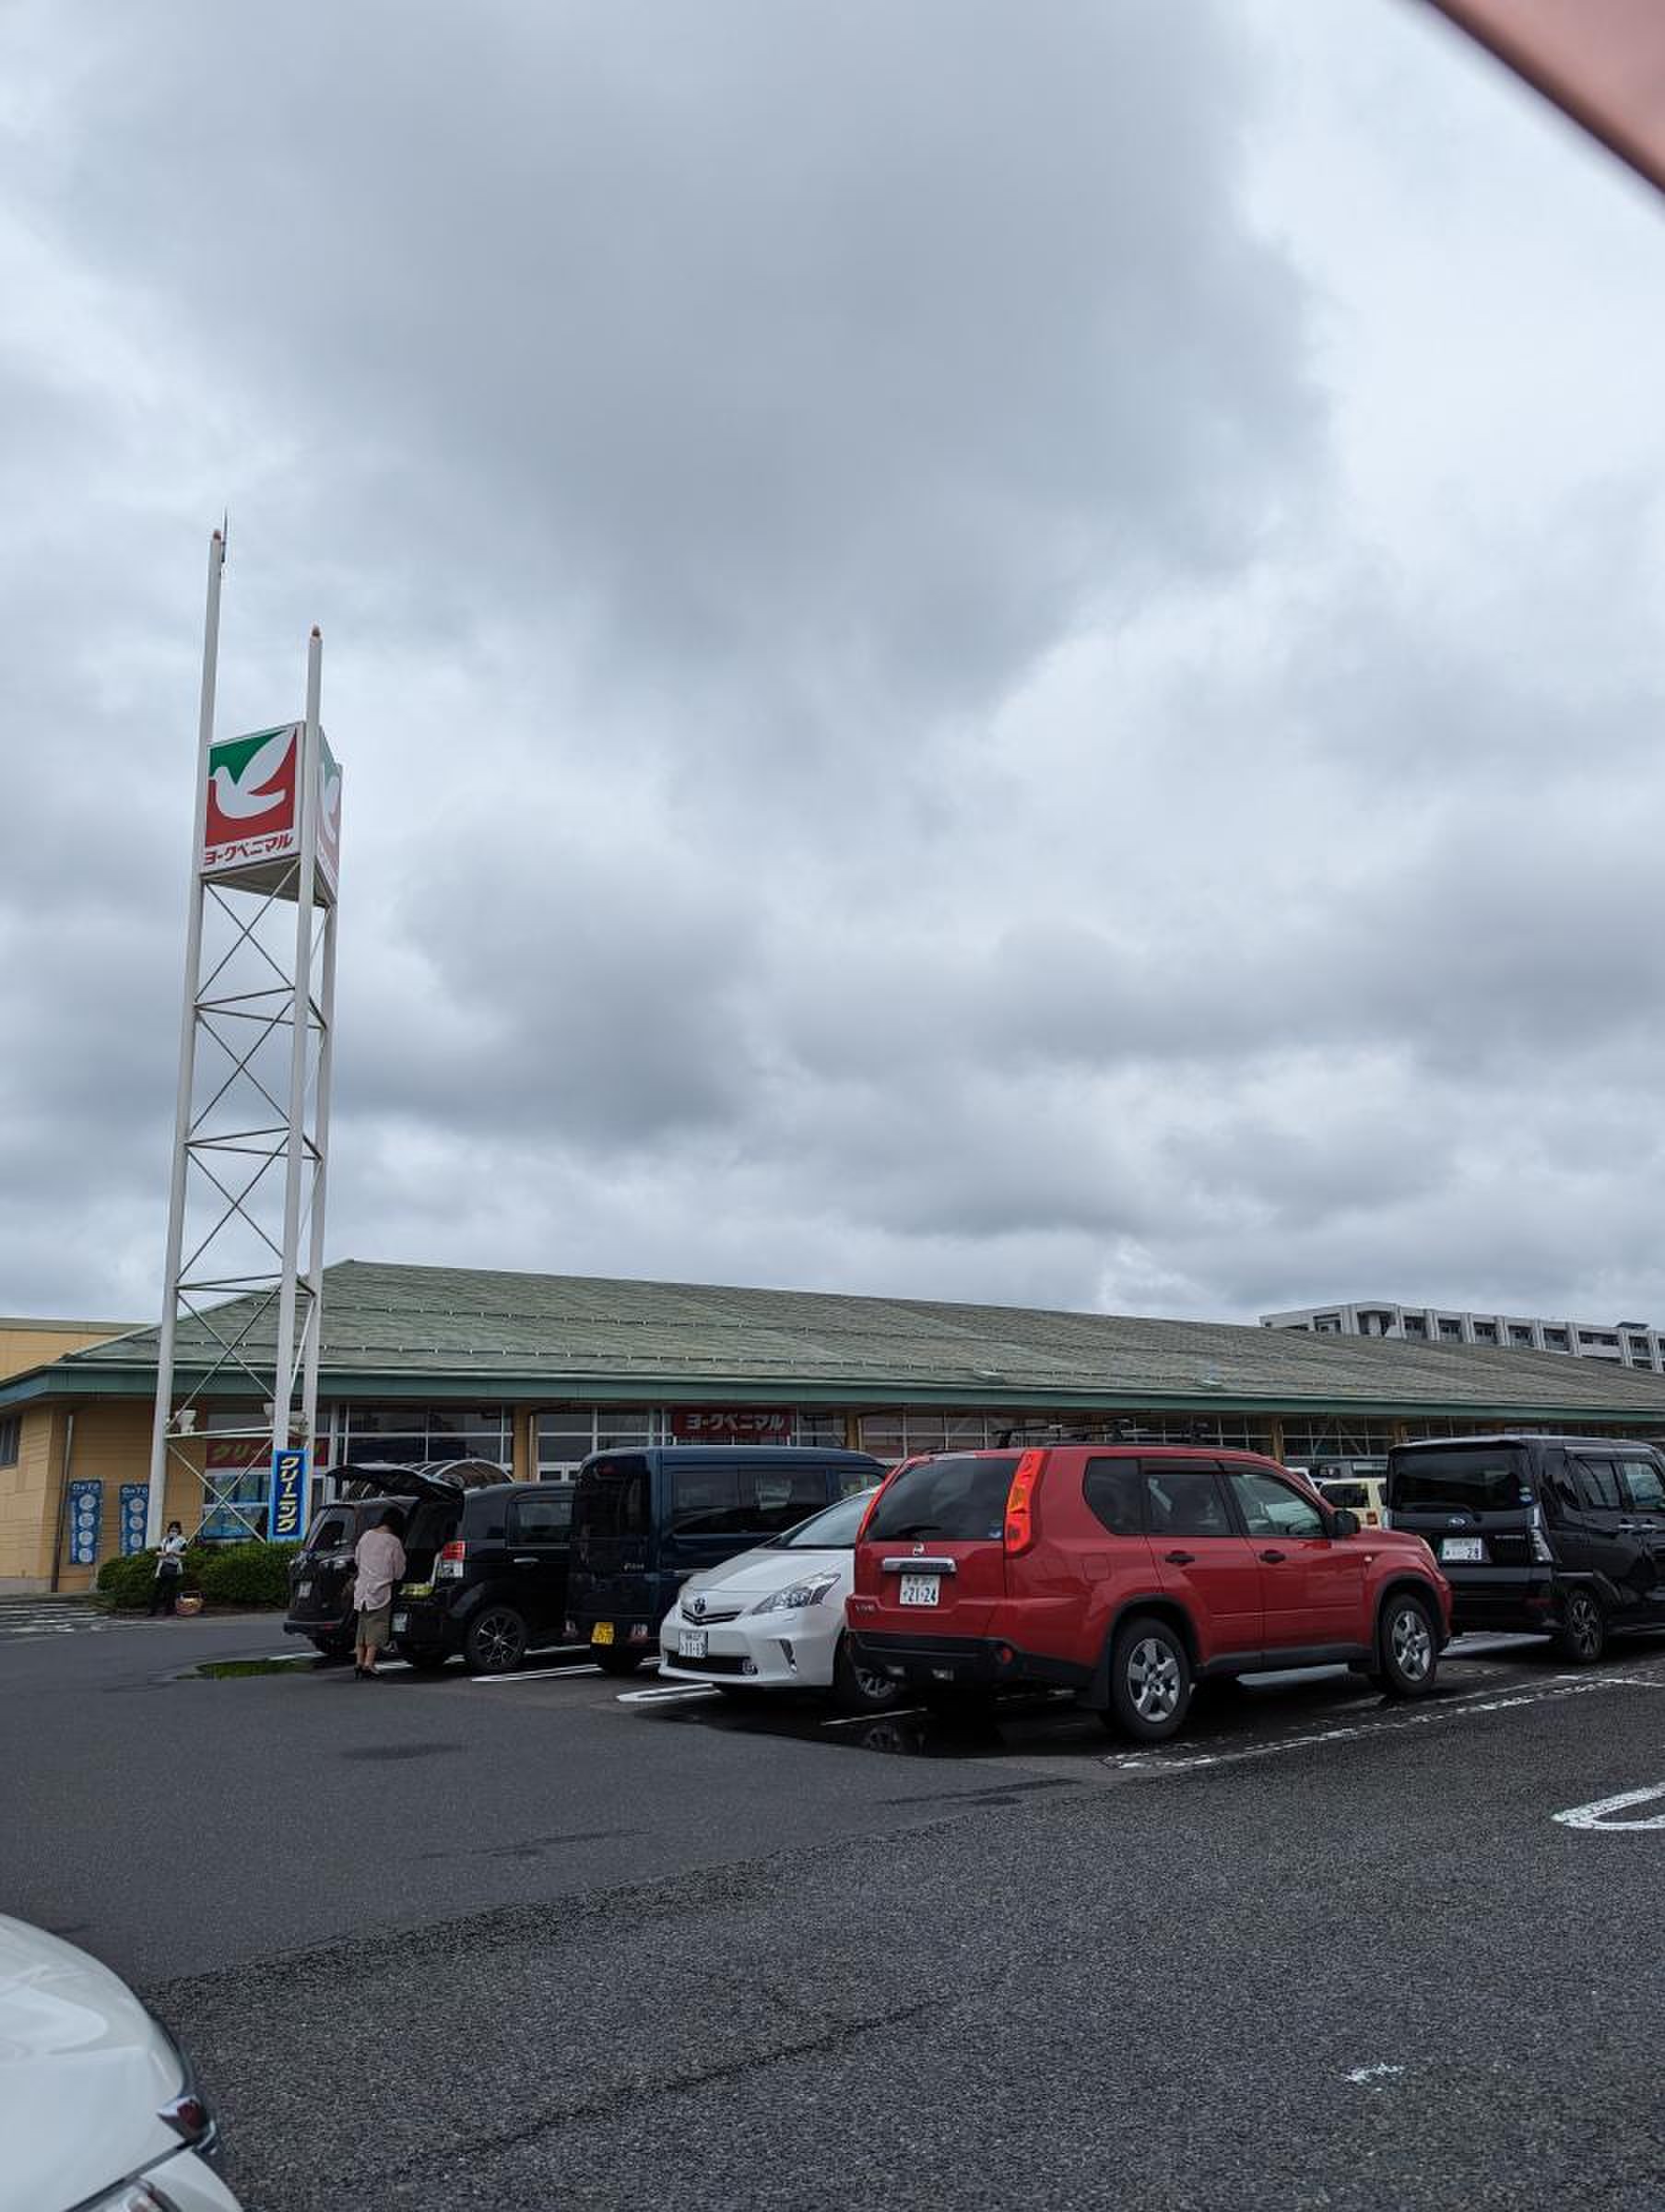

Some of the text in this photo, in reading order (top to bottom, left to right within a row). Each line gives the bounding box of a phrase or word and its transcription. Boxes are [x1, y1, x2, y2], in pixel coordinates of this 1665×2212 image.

[204, 832, 294, 867] ヨークベニマル
[686, 1413, 785, 1431] ヨークベニマル
[278, 1456, 300, 1533] クリーニング
